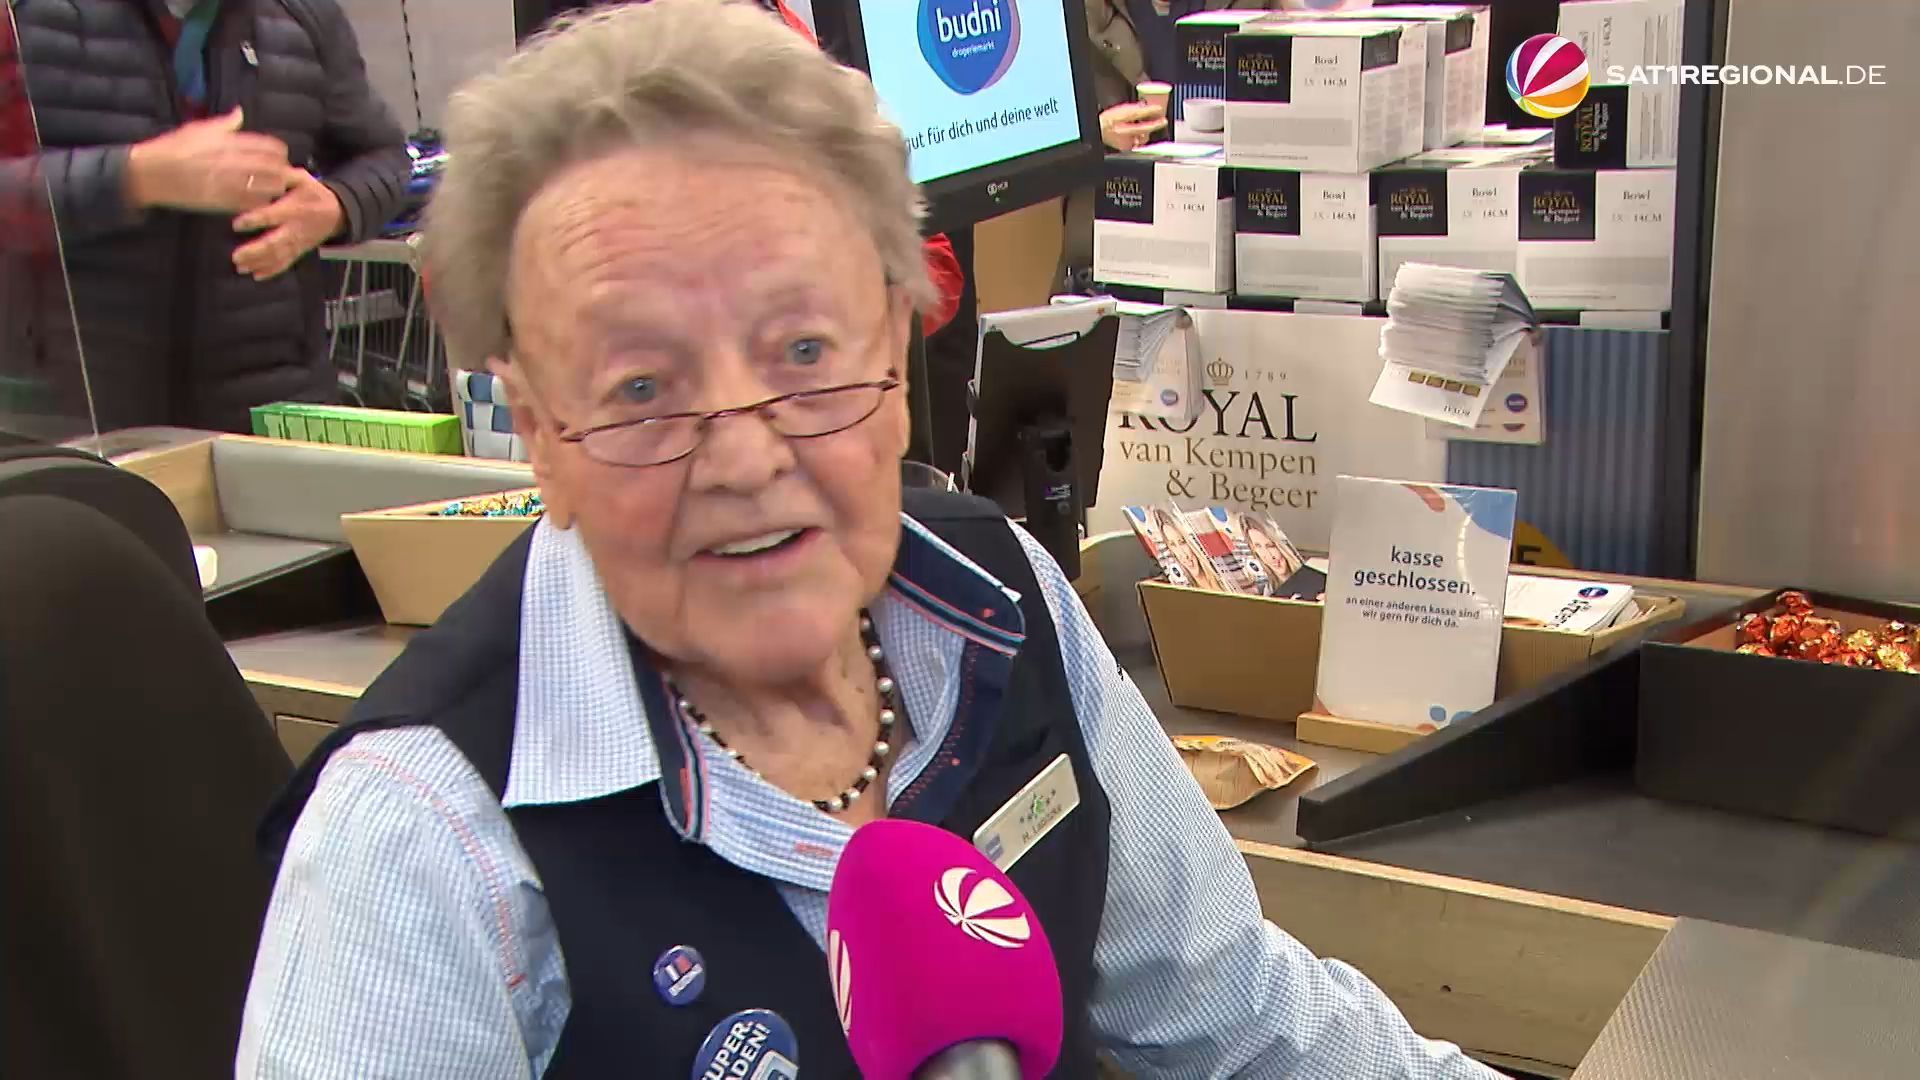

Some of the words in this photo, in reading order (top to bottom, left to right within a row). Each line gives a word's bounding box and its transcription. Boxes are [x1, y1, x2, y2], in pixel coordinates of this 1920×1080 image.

[935, 0, 1002, 43] budni
[1314, 54, 1338, 64] Bowl
[927, 126, 946, 146] für
[948, 119, 974, 140] dich
[975, 111, 998, 134] und
[1000, 107, 1032, 127] deine
[1033, 97, 1060, 118] welt
[1175, 181, 1196, 192] Bowl
[1322, 189, 1346, 200] Bowl
[1243, 369, 1289, 382] 1789
[1119, 440, 1172, 463] van
[1184, 437, 1318, 479] Kempen
[1166, 469, 1197, 499] &
[1210, 471, 1318, 511] Begeer
[1390, 545, 1444, 568] kasse
[1345, 596, 1358, 605] an
[1359, 597, 1384, 608] einer
[1386, 600, 1427, 613] anderen
[1429, 604, 1457, 616] kasse
[1458, 607, 1480, 620] sind
[1362, 609, 1378, 618] wir
[1380, 610, 1402, 622] gern
[1404, 612, 1420, 624] für
[1421, 615, 1442, 626] dich
[1444, 617, 1459, 628] da.
[701, 1020, 756, 1080] UPER.
